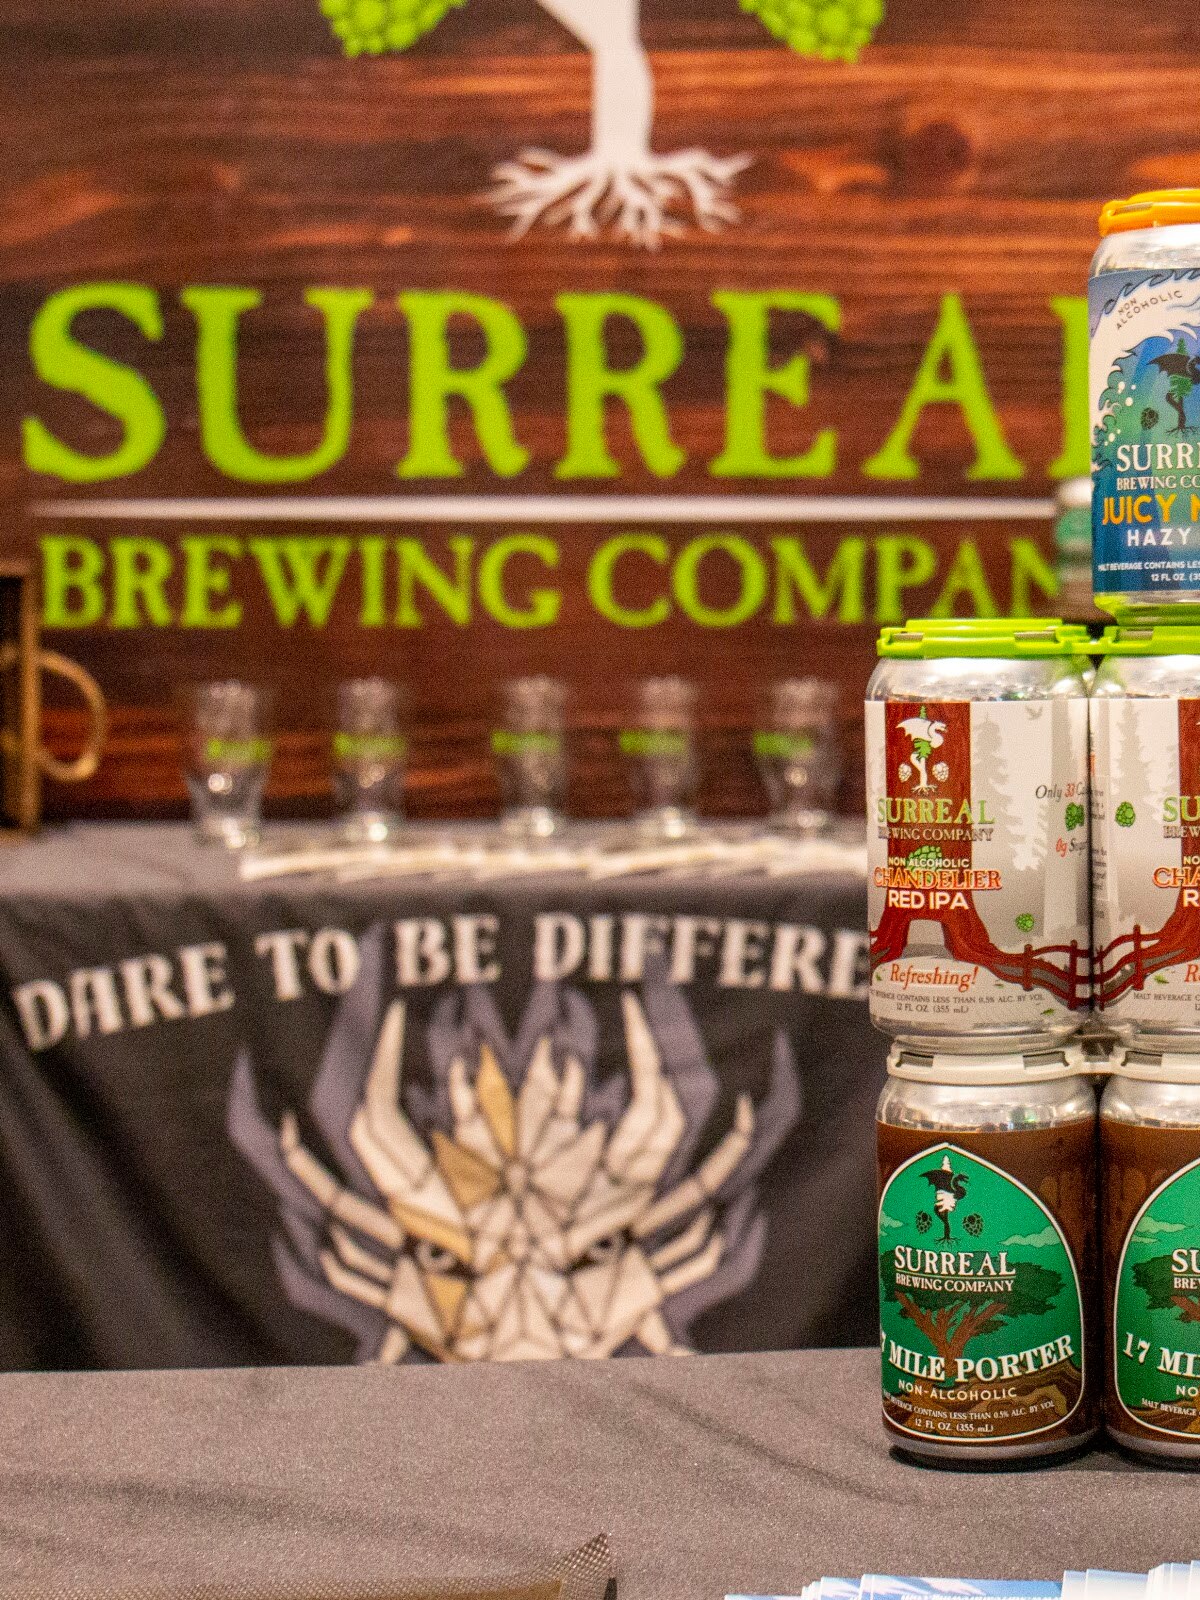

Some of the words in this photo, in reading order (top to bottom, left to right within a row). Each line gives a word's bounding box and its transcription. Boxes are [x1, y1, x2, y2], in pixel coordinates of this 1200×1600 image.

[1117, 291, 1182, 330] ALCOHOLIC
[1118, 298, 1136, 315] NON
[1117, 476, 1177, 490] BREWING
[1102, 494, 1178, 525] JUICY
[1127, 528, 1191, 546] HAZY
[39, 535, 563, 630] BREWING
[1036, 784, 1062, 802] Only
[878, 798, 995, 825] SURREAL
[889, 856, 905, 867] NON
[909, 857, 970, 868] ALCOHOLIC
[873, 867, 1002, 890] CHANDELIER
[889, 891, 924, 909] RED
[929, 891, 969, 910] IPA
[12, 941, 235, 1052] DARE
[254, 927, 360, 1001] TO
[395, 913, 500, 987] BE
[890, 963, 979, 993] Refreshing!
[894, 1245, 1016, 1276] SURREAL
[895, 1273, 942, 1290] BREWING
[944, 1280, 1014, 1292] COMPANY
[888, 1340, 946, 1381] MILE
[955, 1335, 1074, 1382] PORTER
[1123, 1332, 1150, 1364] 17
[898, 1379, 1017, 1401] NON-ALCOHOLIC
